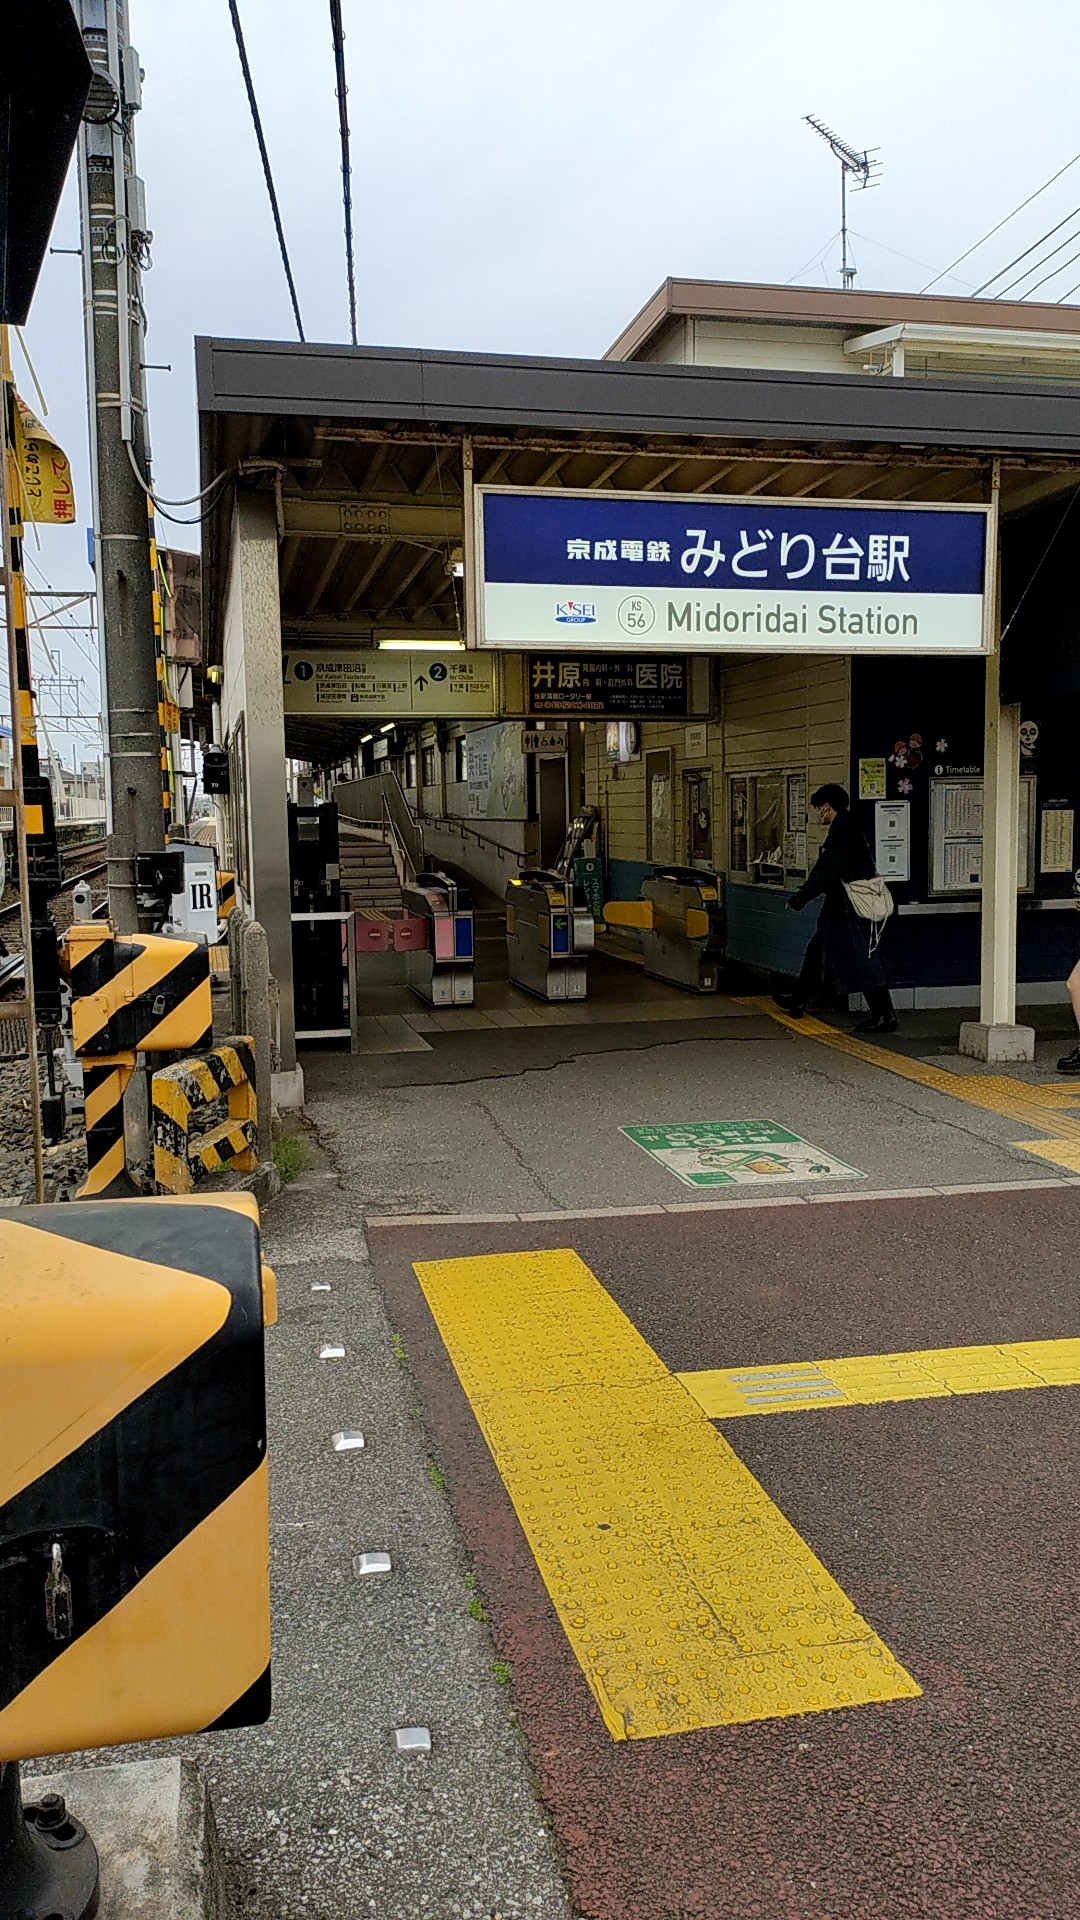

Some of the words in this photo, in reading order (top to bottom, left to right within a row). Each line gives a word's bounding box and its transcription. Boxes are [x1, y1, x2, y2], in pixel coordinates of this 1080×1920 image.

[24, 439, 42, 498] とじこめら
[50, 444, 73, 519] 押して
[566, 538, 671, 562] 京成電鉄
[680, 528, 911, 583] みどり台駅
[631, 601, 642, 612] KS
[667, 602, 808, 635] Midoridai
[817, 604, 919, 636] Station
[627, 613, 646, 629] 56
[532, 661, 581, 689] 井原
[636, 663, 683, 689] 医院
[946, 765, 981, 774] Timetable
[190, 883, 213, 910] IR
